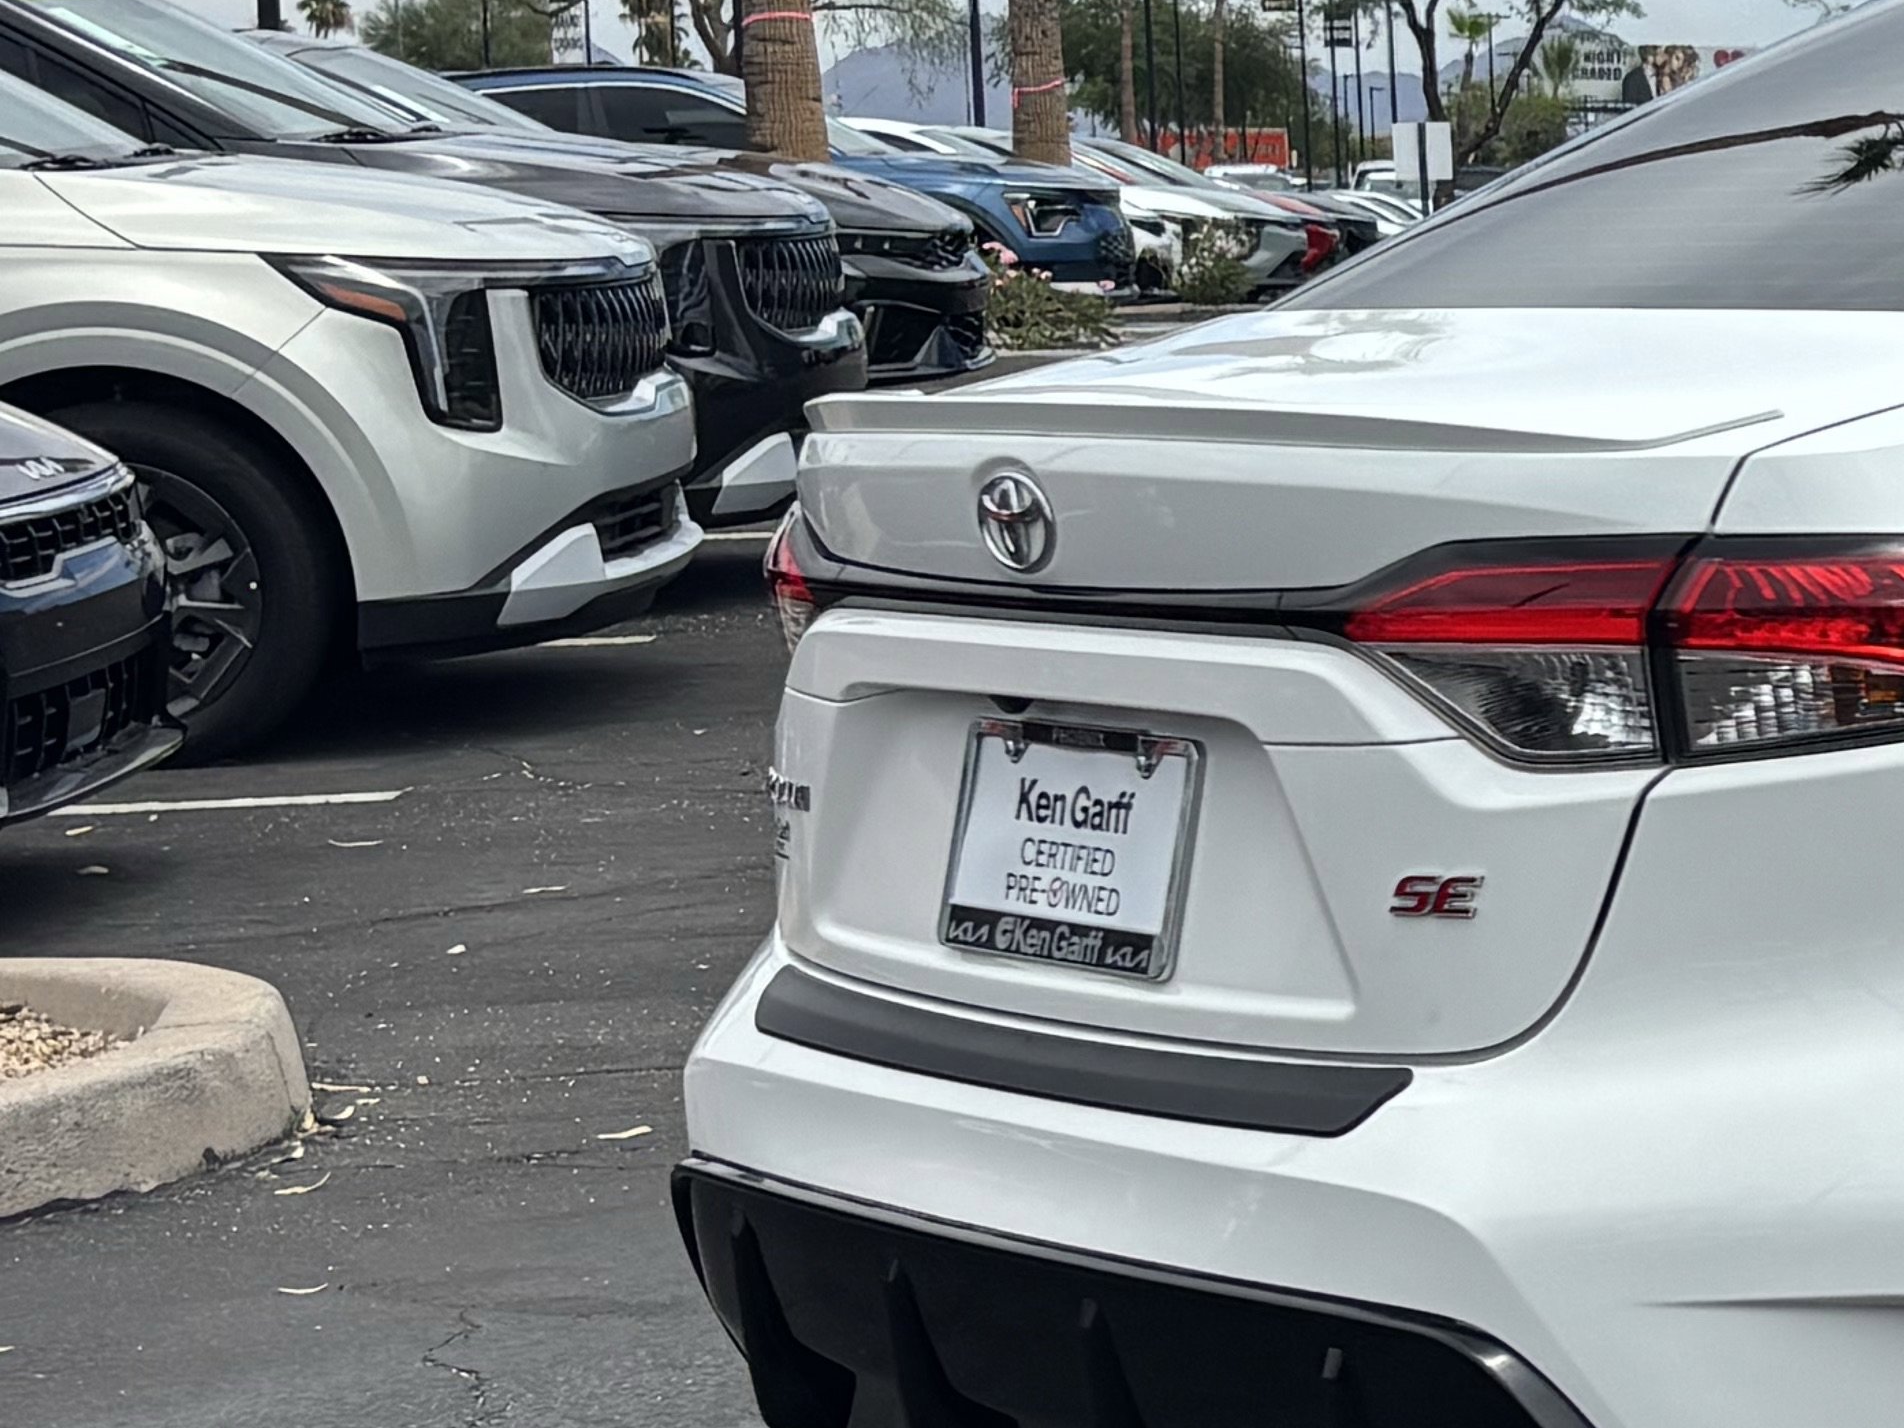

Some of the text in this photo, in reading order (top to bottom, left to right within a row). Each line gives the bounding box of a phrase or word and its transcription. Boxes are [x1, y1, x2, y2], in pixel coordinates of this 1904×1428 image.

[1014, 776, 1136, 835] Ken Garff
[1020, 837, 1116, 877] CERTIFIED
[1005, 872, 1121, 916] PRE-OWNED
[1388, 875, 1485, 919] SE
[949, 918, 1150, 969] KIA Ken Garff KIA
